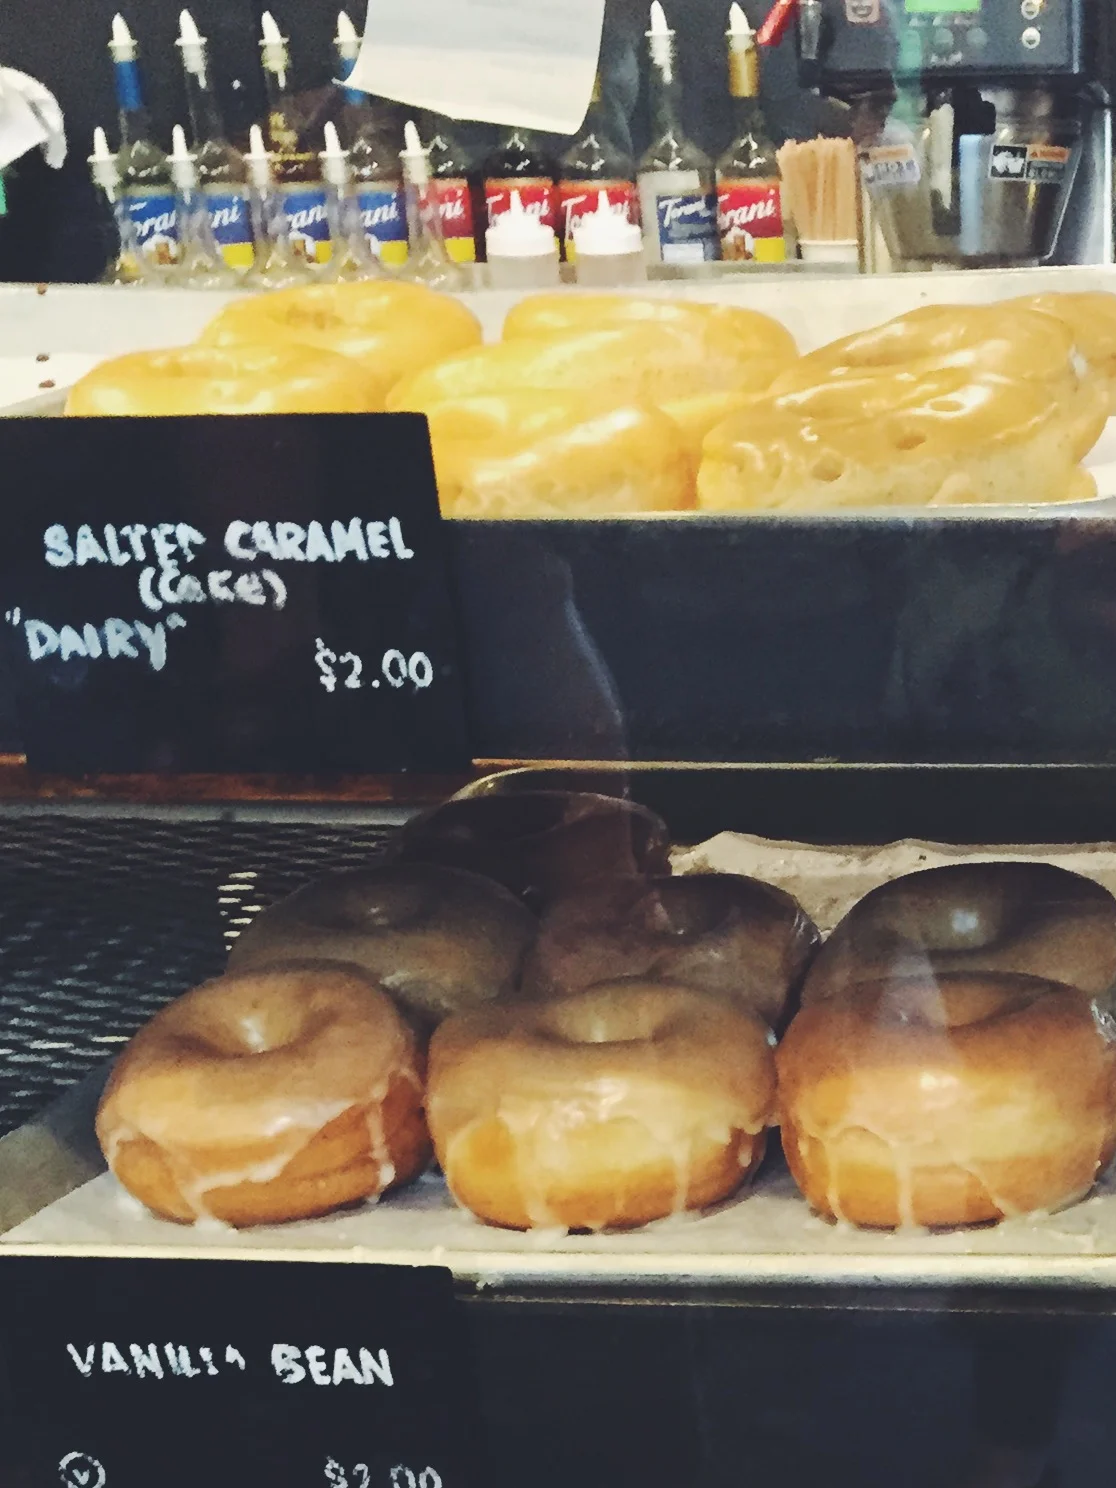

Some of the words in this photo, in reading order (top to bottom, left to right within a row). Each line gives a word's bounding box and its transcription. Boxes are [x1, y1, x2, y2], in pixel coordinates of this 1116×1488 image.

[224, 517, 414, 562] CARAMEL
[315, 637, 434, 692] $2.00
[271, 1344, 394, 1386] BEAN
